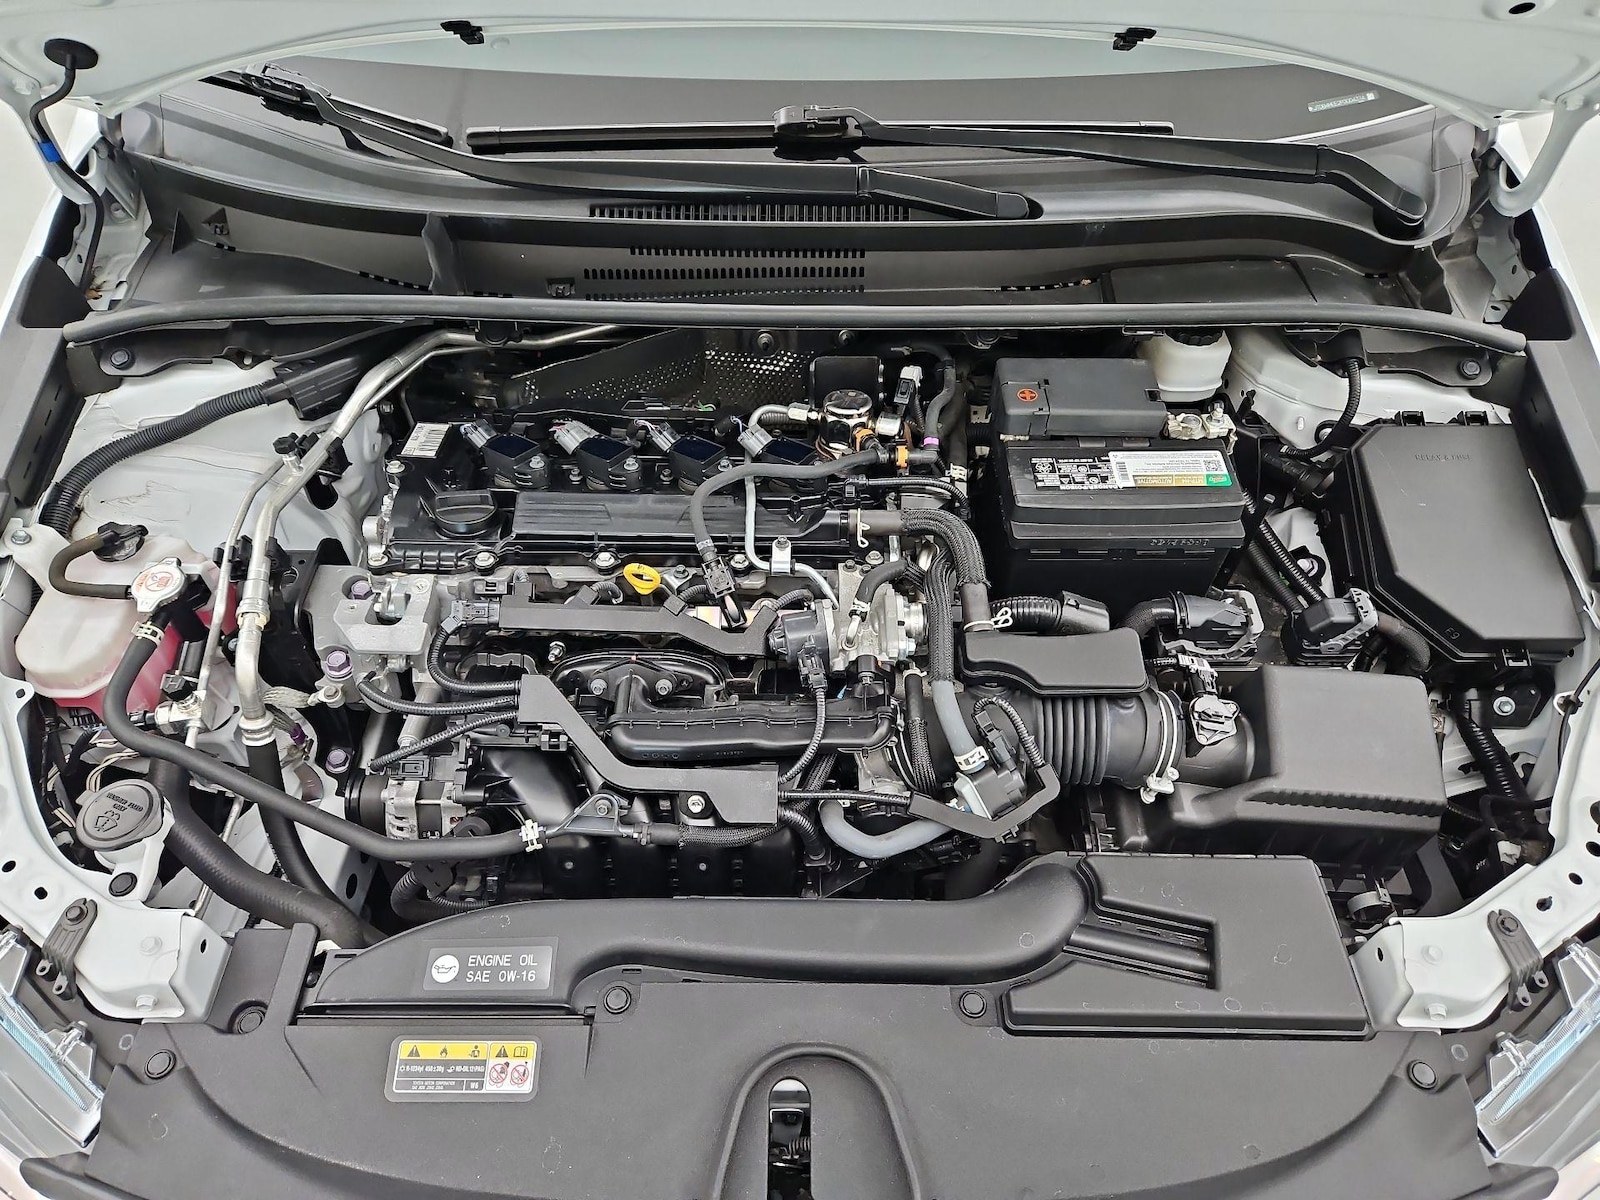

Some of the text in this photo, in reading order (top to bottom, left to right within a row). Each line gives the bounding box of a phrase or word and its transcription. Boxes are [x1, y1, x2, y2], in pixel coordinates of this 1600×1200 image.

[467, 954, 538, 967] ENGINE OIL
[465, 970, 536, 983] SAE 0W-16
